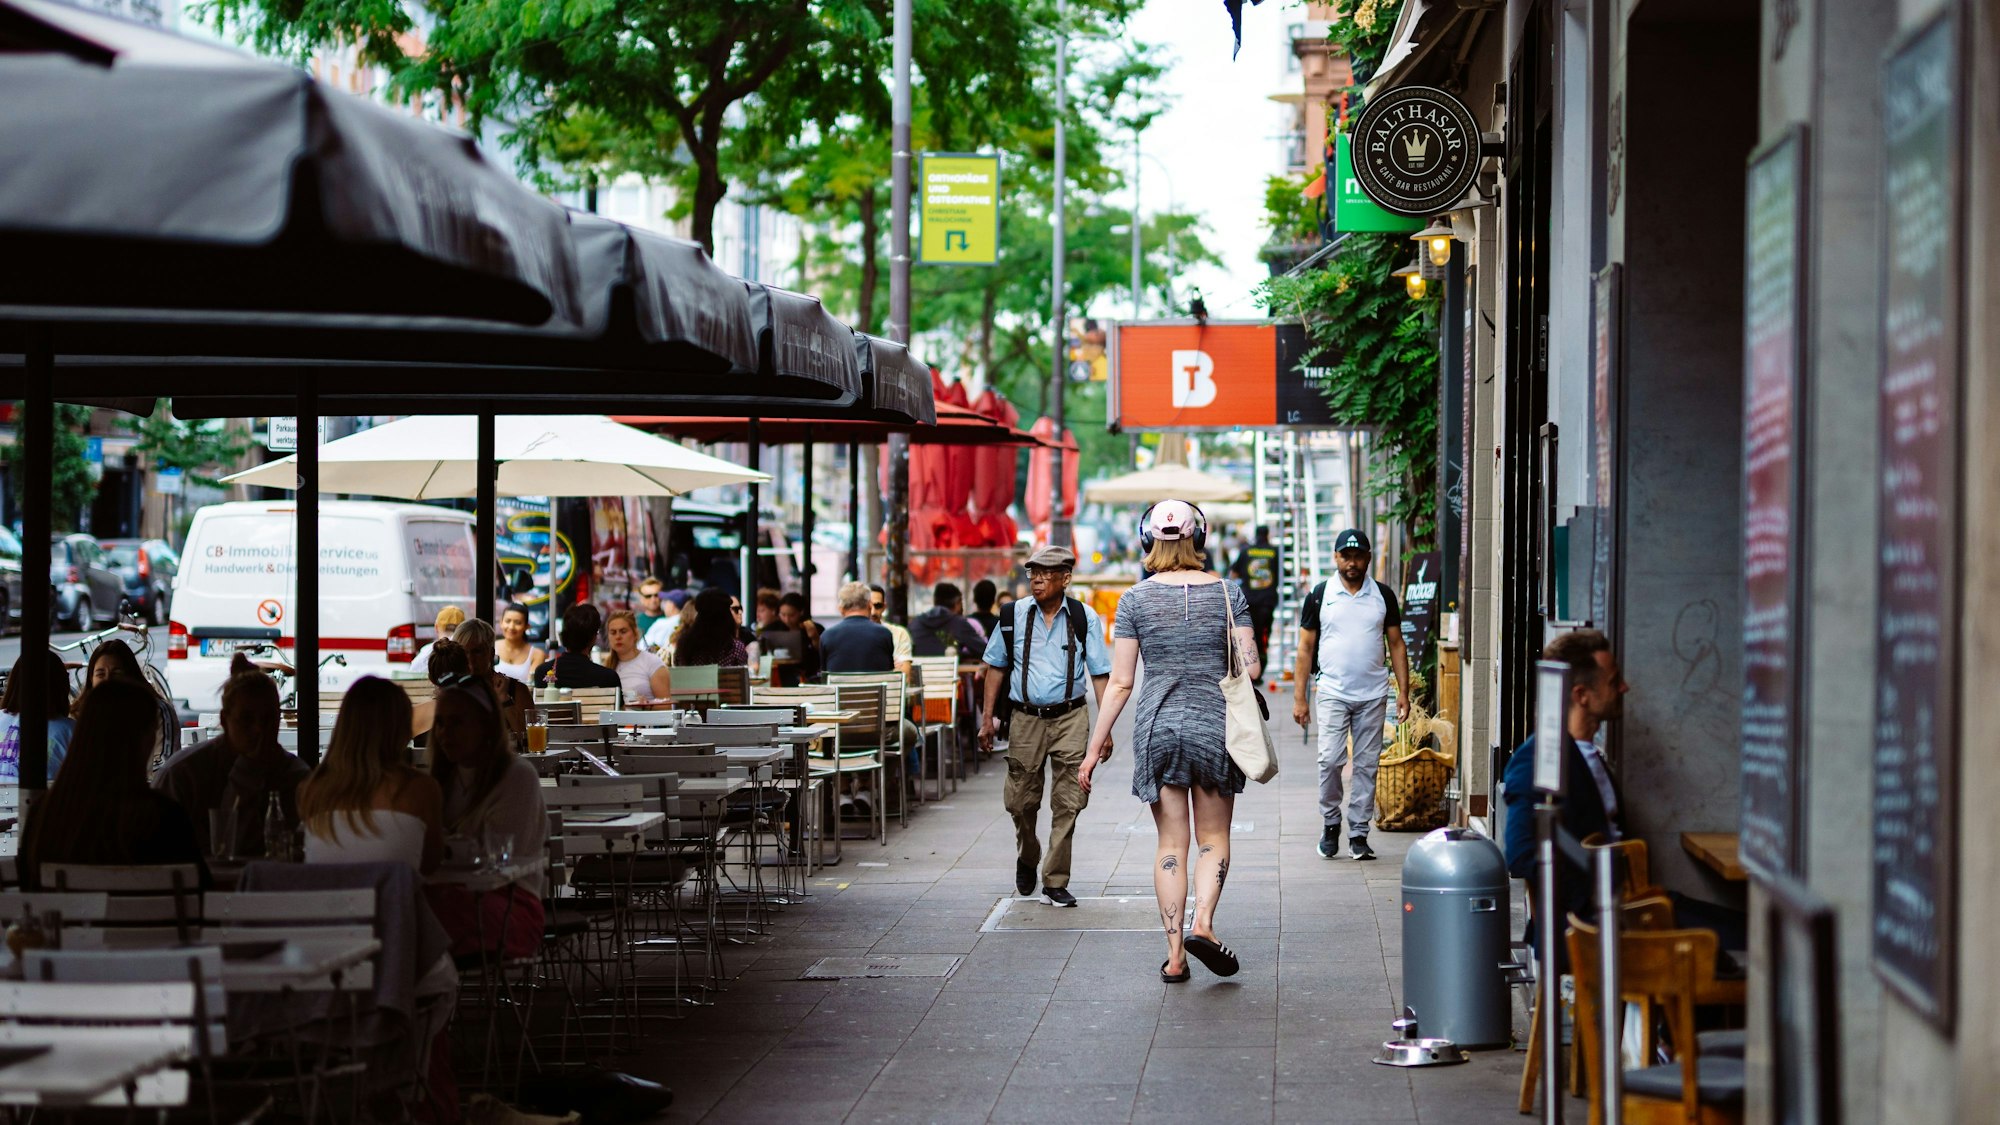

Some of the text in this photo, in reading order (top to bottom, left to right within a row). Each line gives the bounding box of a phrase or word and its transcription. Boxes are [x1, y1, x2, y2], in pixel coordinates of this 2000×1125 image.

[1372, 105, 1461, 152] BALTHASAR
[1379, 164, 1455, 193] CAFE BAR RESTAURANT
[205, 563, 265, 574] Handwerk
[266, 564, 274, 574] &
